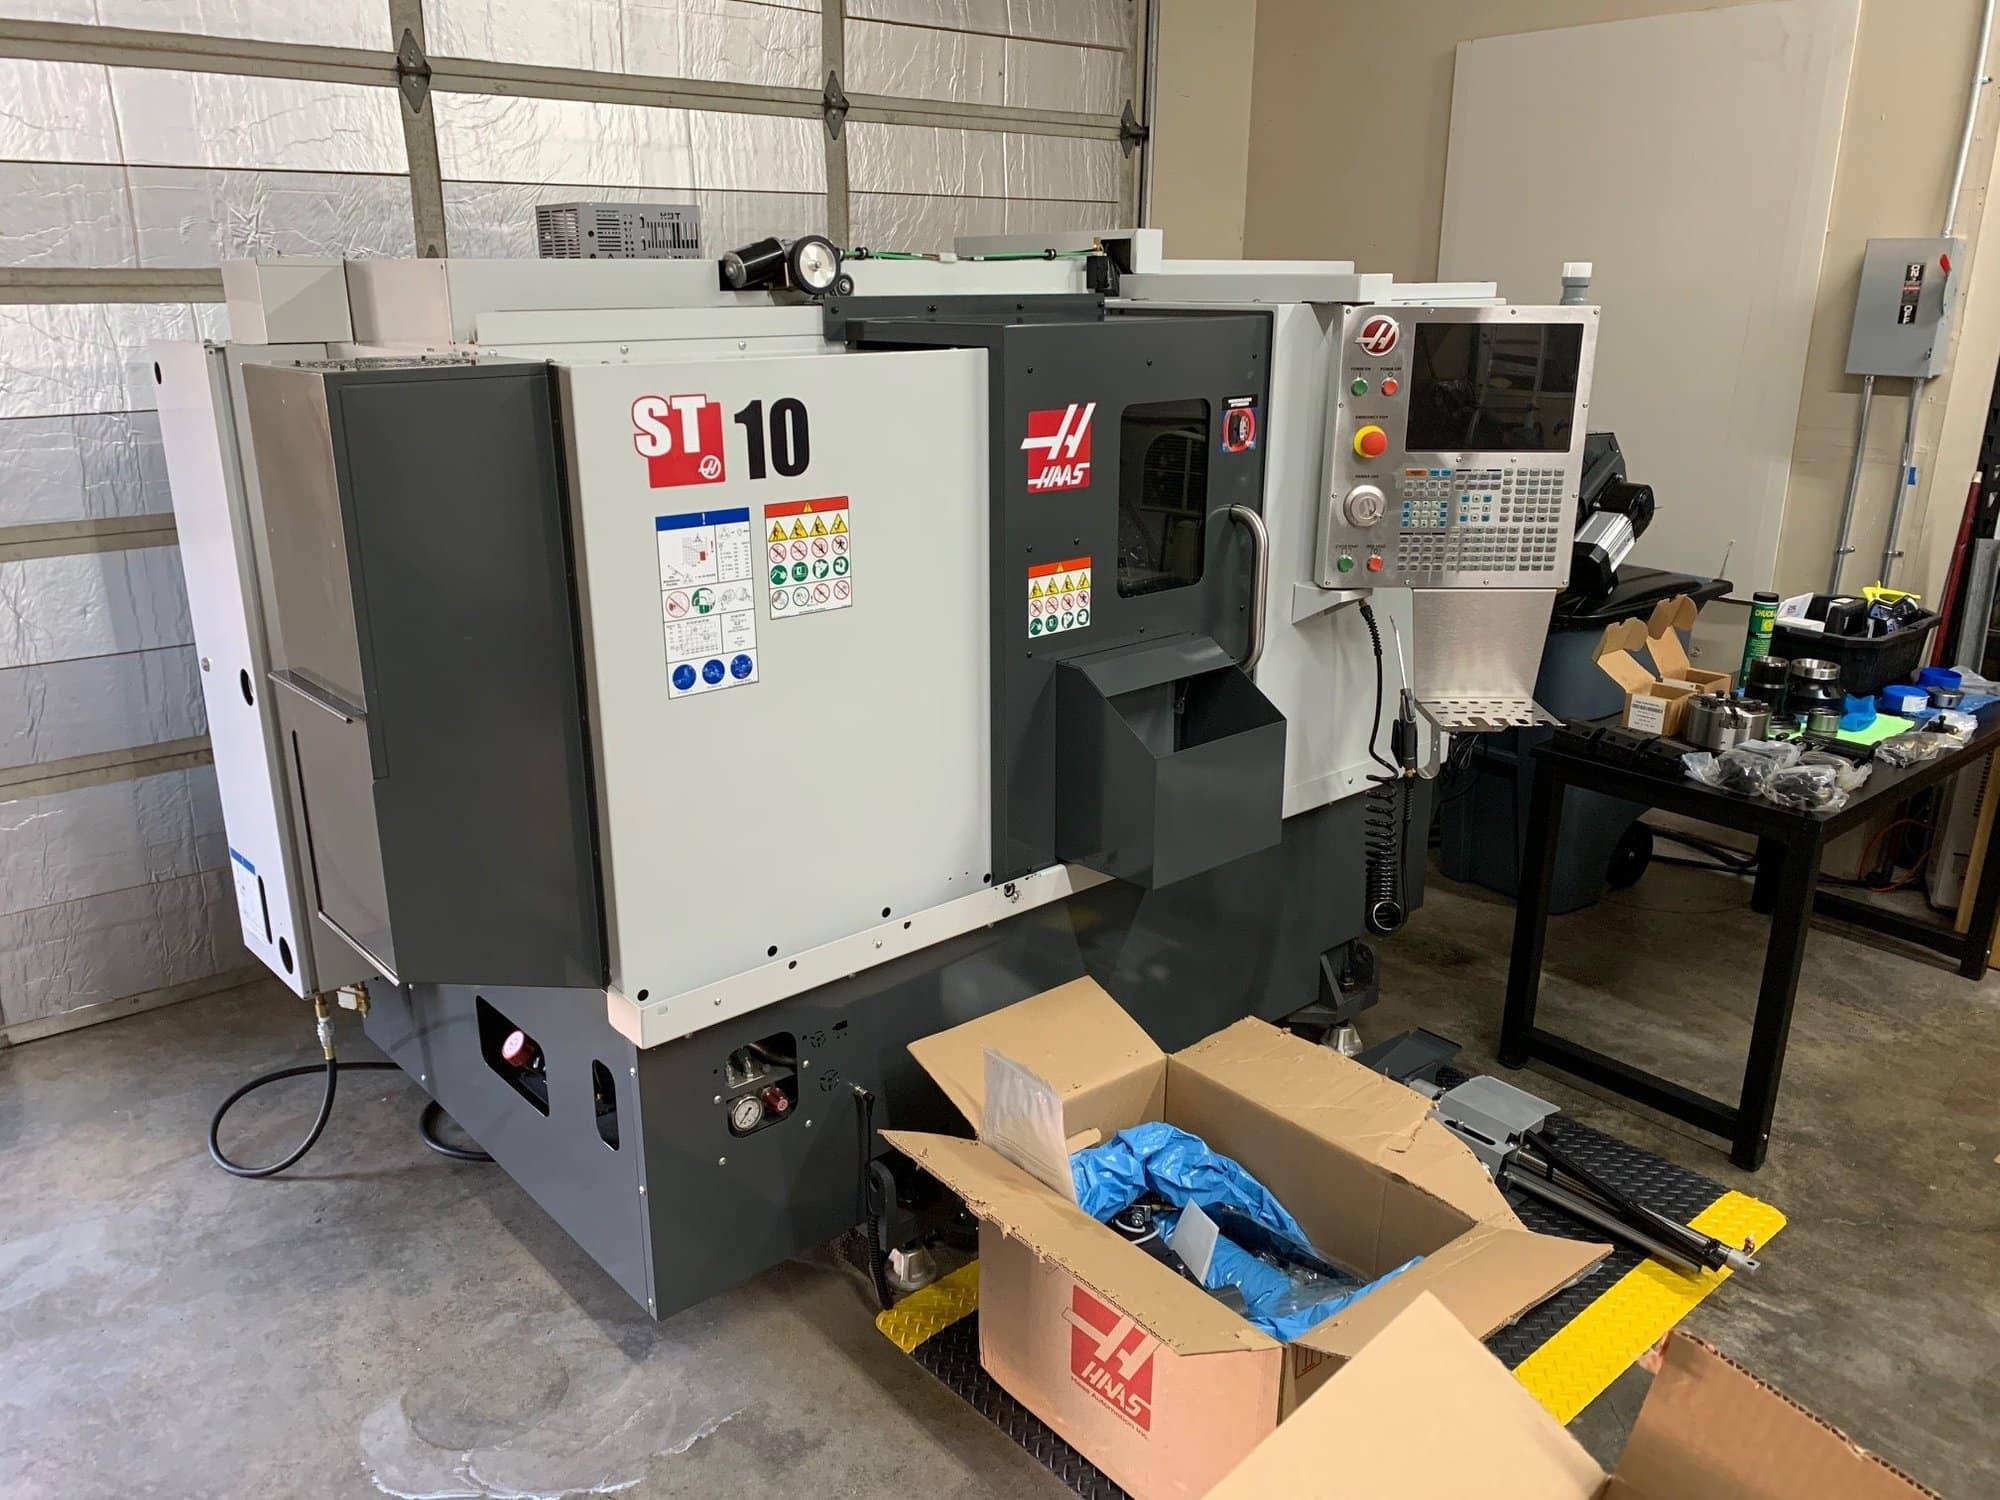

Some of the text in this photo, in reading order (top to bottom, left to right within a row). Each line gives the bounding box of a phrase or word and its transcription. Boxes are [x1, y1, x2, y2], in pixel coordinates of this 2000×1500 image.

[1910, 264, 1920, 277] ON
[1903, 305, 1913, 325] OFF
[632, 393, 810, 480] ST 10
[1027, 462, 1090, 489] HAAS
[1081, 1361, 1152, 1417] HAAS
